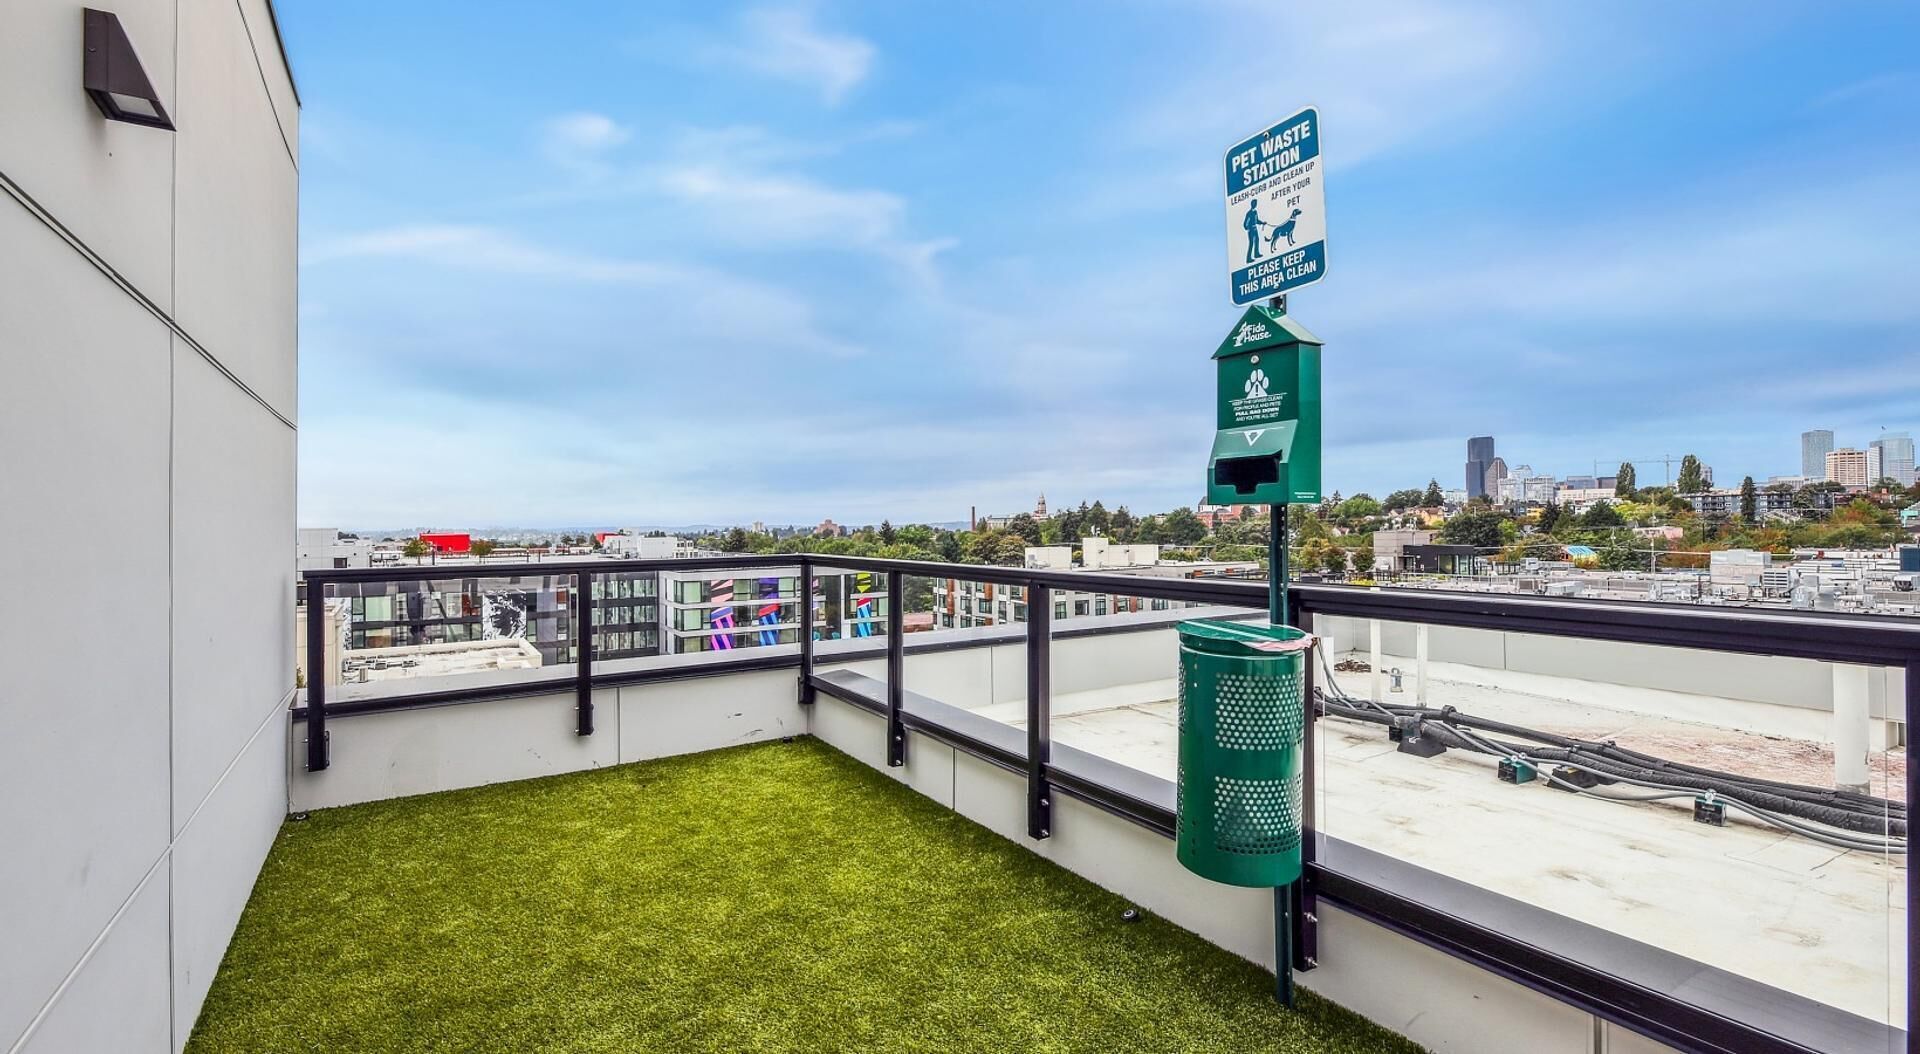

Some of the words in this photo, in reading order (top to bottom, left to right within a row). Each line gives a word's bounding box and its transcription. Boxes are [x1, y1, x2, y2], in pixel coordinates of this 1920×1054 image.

[1231, 146, 1257, 173] PET
[1260, 119, 1311, 158] WASTE
[1243, 145, 1300, 186] STATION
[1230, 183, 1267, 206] LEASH-CURB
[1269, 176, 1281, 189] AND
[1283, 167, 1304, 182] CLEAN
[1305, 161, 1315, 172] UP
[1271, 186, 1292, 201] AFTER
[1292, 177, 1311, 191] YOUR
[1286, 195, 1301, 208] PET
[1239, 280, 1259, 296] THIS
[1261, 271, 1285, 289] AREA
[1286, 260, 1317, 280] CLEAN
[1247, 259, 1280, 280] PLEASE
[1283, 249, 1306, 268] KEEP
[1243, 331, 1272, 343] House
[1248, 321, 1266, 333] Fido
